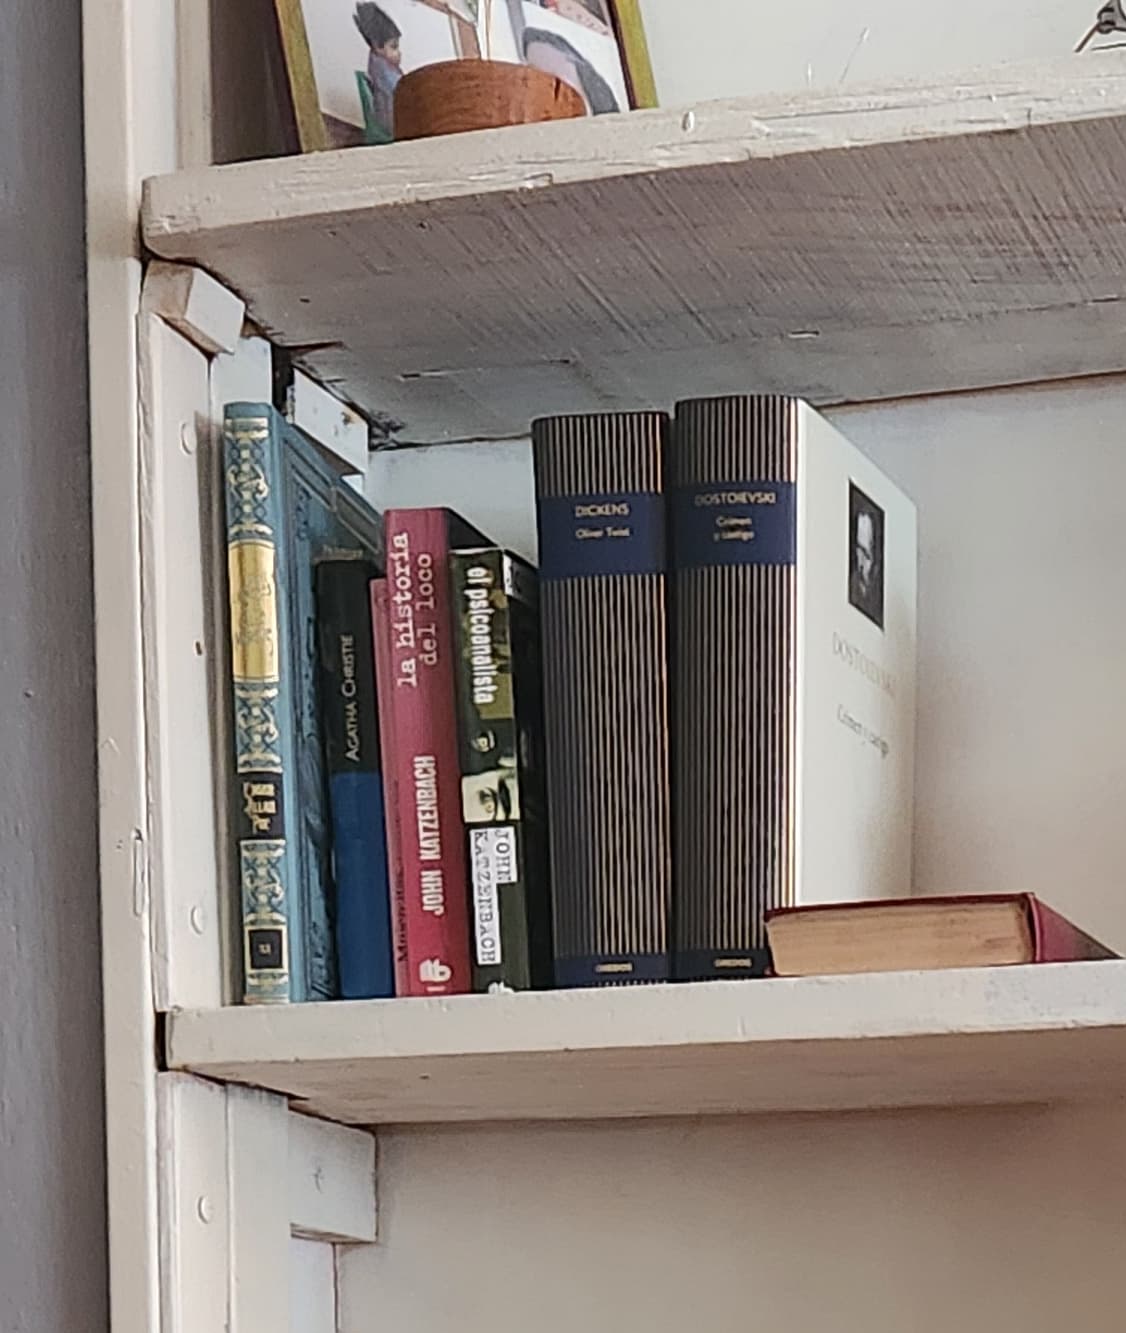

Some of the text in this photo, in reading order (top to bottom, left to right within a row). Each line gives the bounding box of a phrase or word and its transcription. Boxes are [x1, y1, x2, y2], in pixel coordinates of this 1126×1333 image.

[574, 503, 630, 518] DICKENS
[695, 491, 777, 506] DOSTOIEVSKI
[388, 532, 417, 687] la historia
[415, 553, 437, 666] del loco
[463, 567, 499, 705] el psicoanalista
[413, 755, 444, 916] JOHN KATZENBACH
[473, 830, 496, 962] KATZENBACH
[494, 829, 514, 883] JOHN
